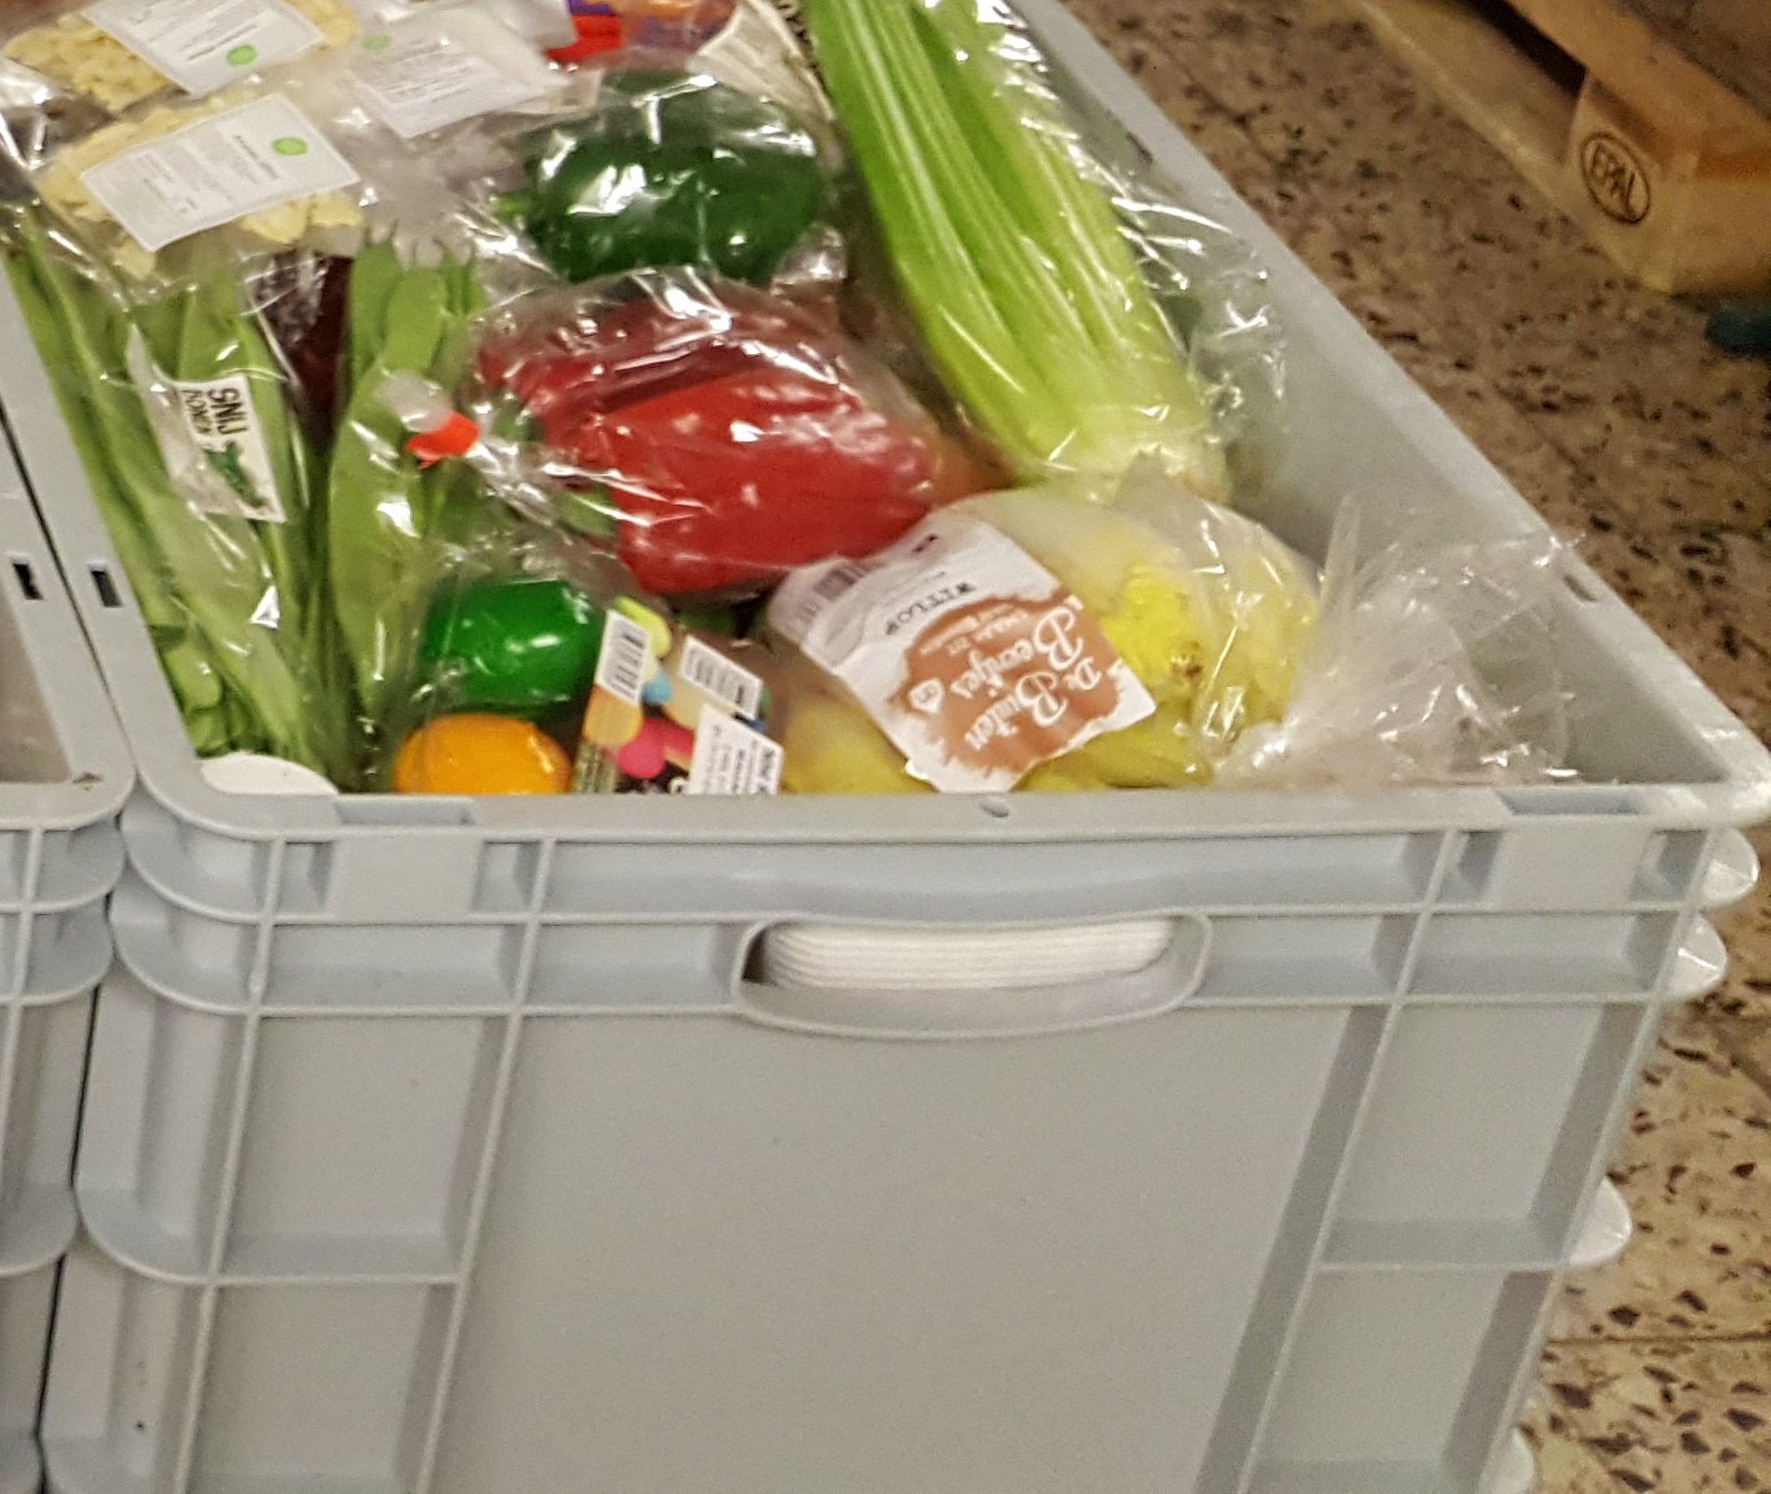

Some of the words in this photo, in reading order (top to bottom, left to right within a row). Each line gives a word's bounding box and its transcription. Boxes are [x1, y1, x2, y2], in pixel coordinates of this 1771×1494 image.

[209, 386, 249, 436] SNIJ
[949, 606, 1085, 700] Beentjes
[1062, 656, 1102, 690] De
[963, 670, 1069, 751] Buiten
